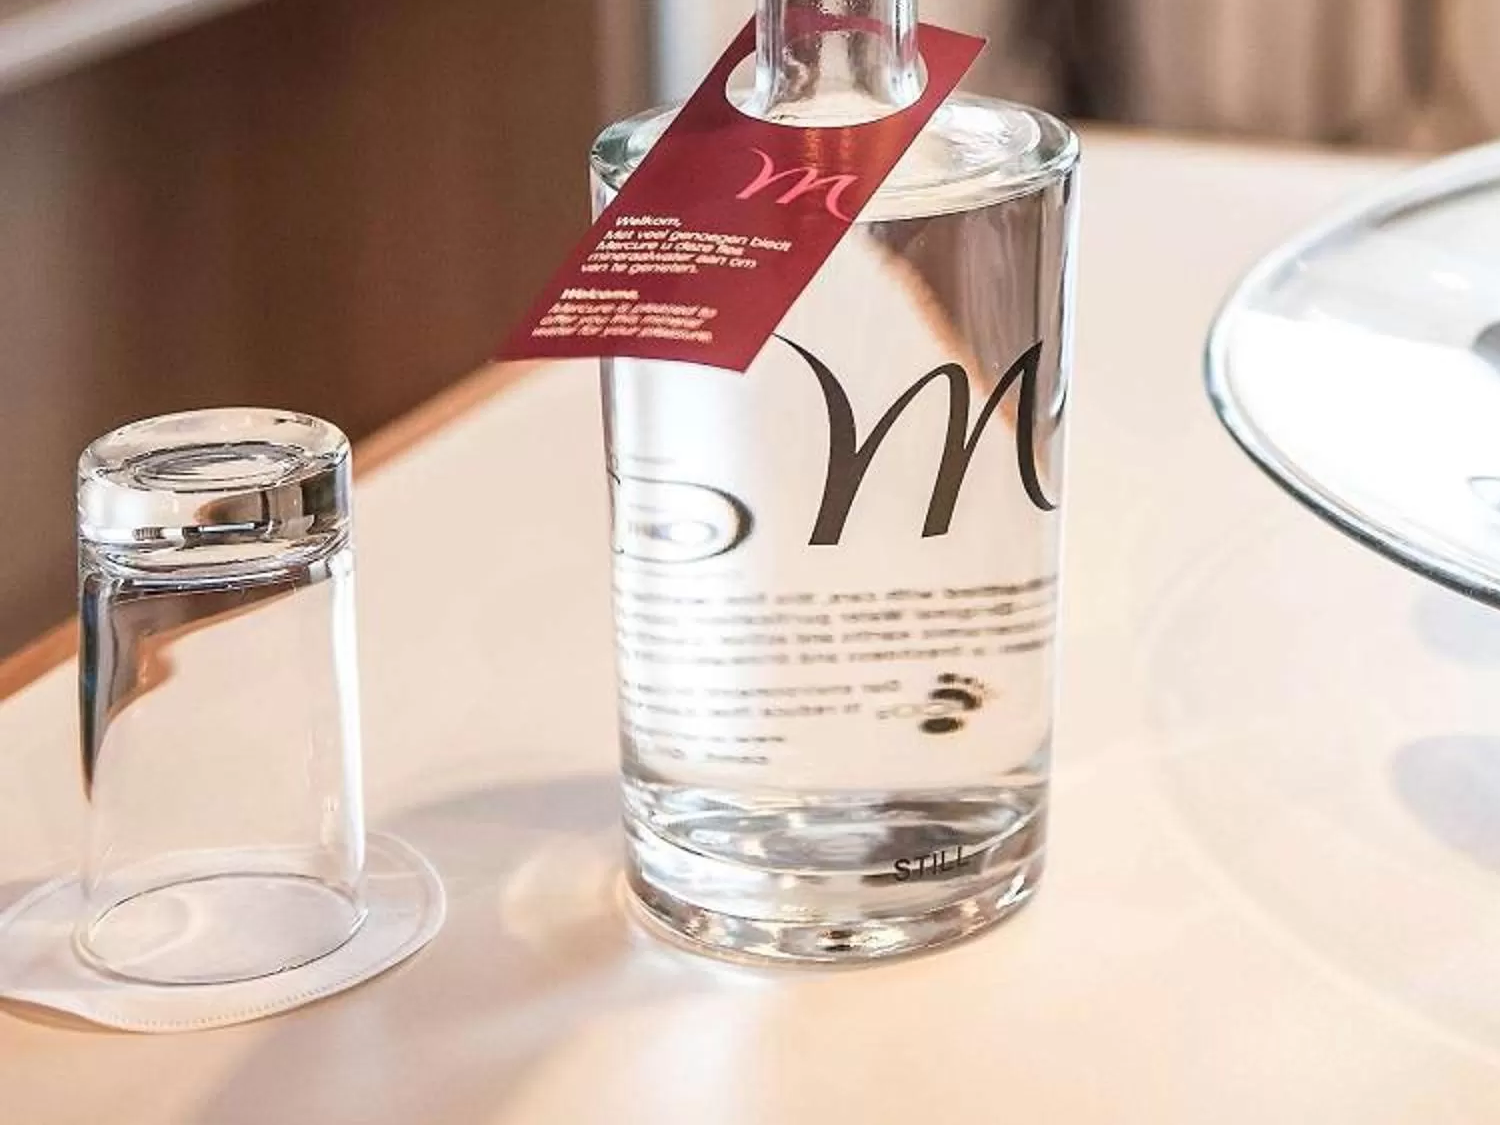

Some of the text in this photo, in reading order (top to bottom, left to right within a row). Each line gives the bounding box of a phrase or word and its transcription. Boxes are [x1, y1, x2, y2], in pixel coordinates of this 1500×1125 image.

[616, 215, 682, 227] Welkom,
[595, 240, 659, 251] Mercure
[674, 240, 714, 252] deze
[604, 229, 792, 251] Met veel genoegen biedt
[587, 250, 695, 262] mineraalwater
[894, 845, 969, 882] STILL
